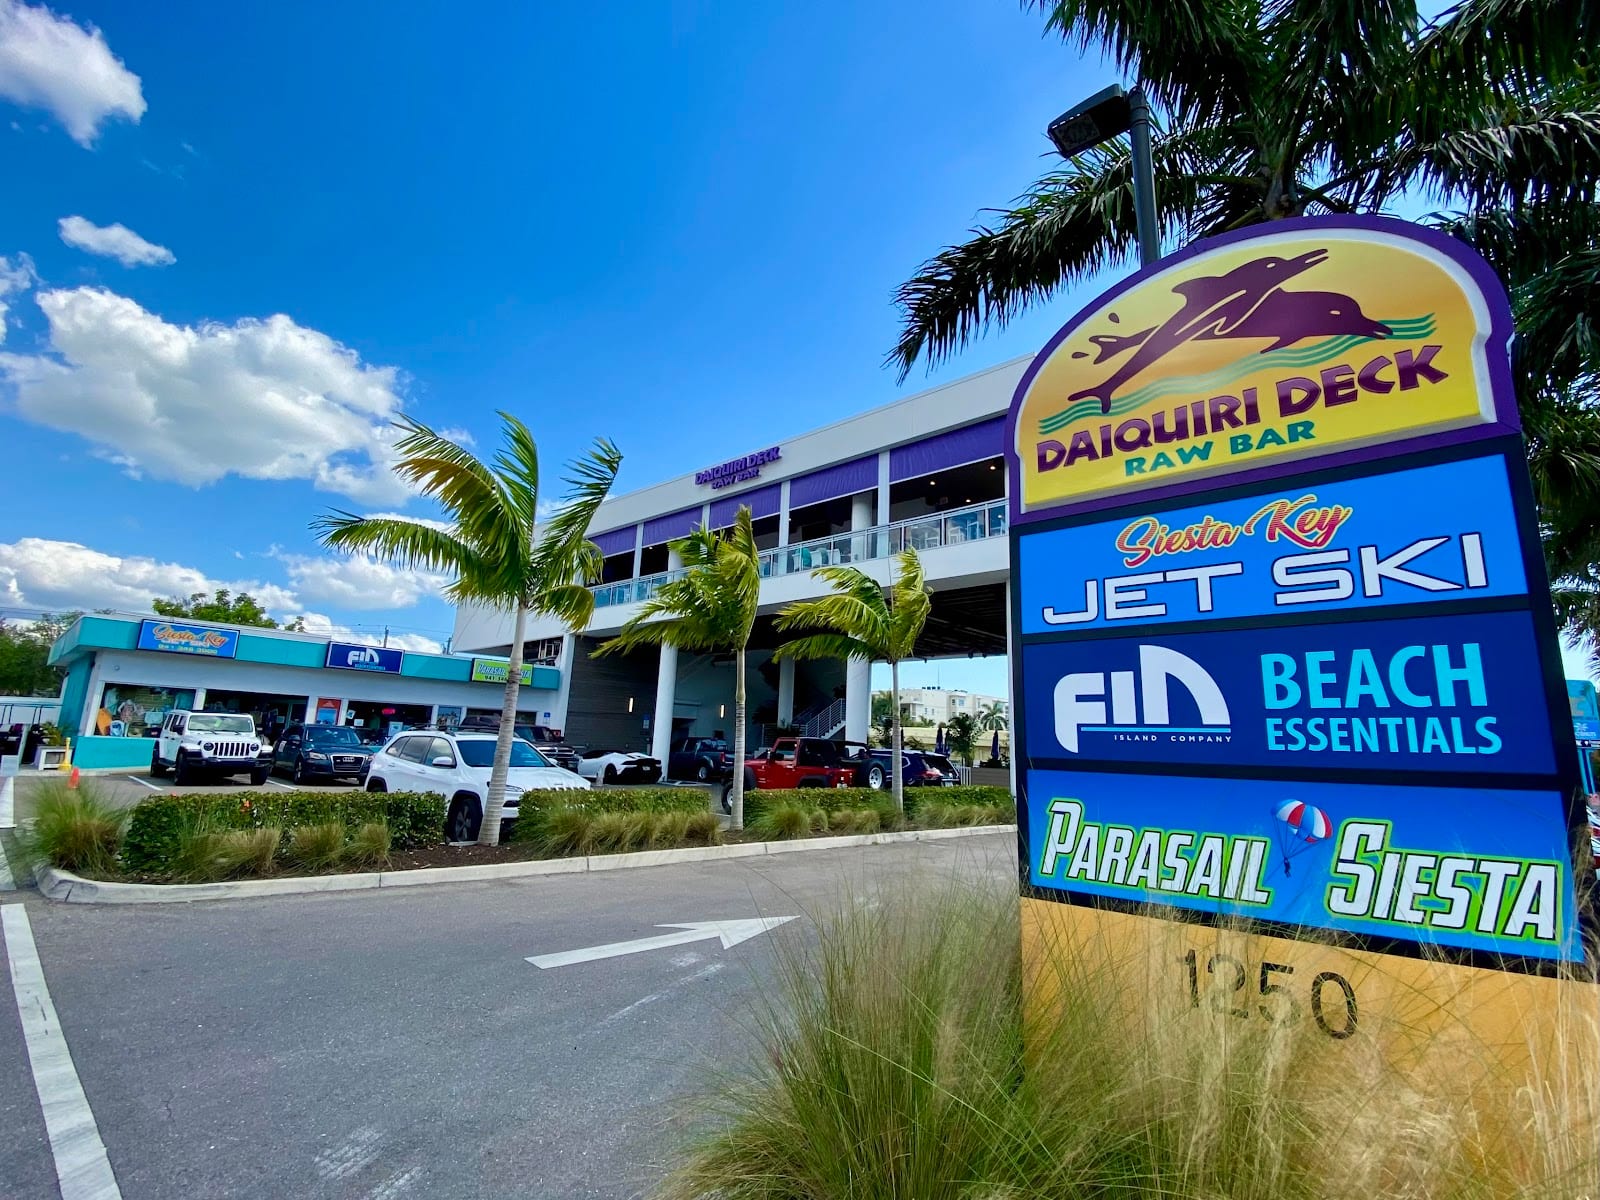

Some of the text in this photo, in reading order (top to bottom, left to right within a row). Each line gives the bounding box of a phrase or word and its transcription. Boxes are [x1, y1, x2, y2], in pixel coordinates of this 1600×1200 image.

[1037, 345, 1449, 473] DAIQUIRI DECK
[747, 446, 782, 467] DECK
[1125, 420, 1316, 477] RAW BAR
[1115, 494, 1354, 569] Siesta Key
[1043, 533, 1488, 625] JET SKI
[1260, 643, 1488, 710] BEACH
[1113, 734, 1232, 743] ISLAND COMPANY
[1266, 716, 1503, 755] ESSENTIALS
[1040, 798, 1563, 944] PARASAIL SIESTA
[1178, 949, 1359, 1040] 1250
